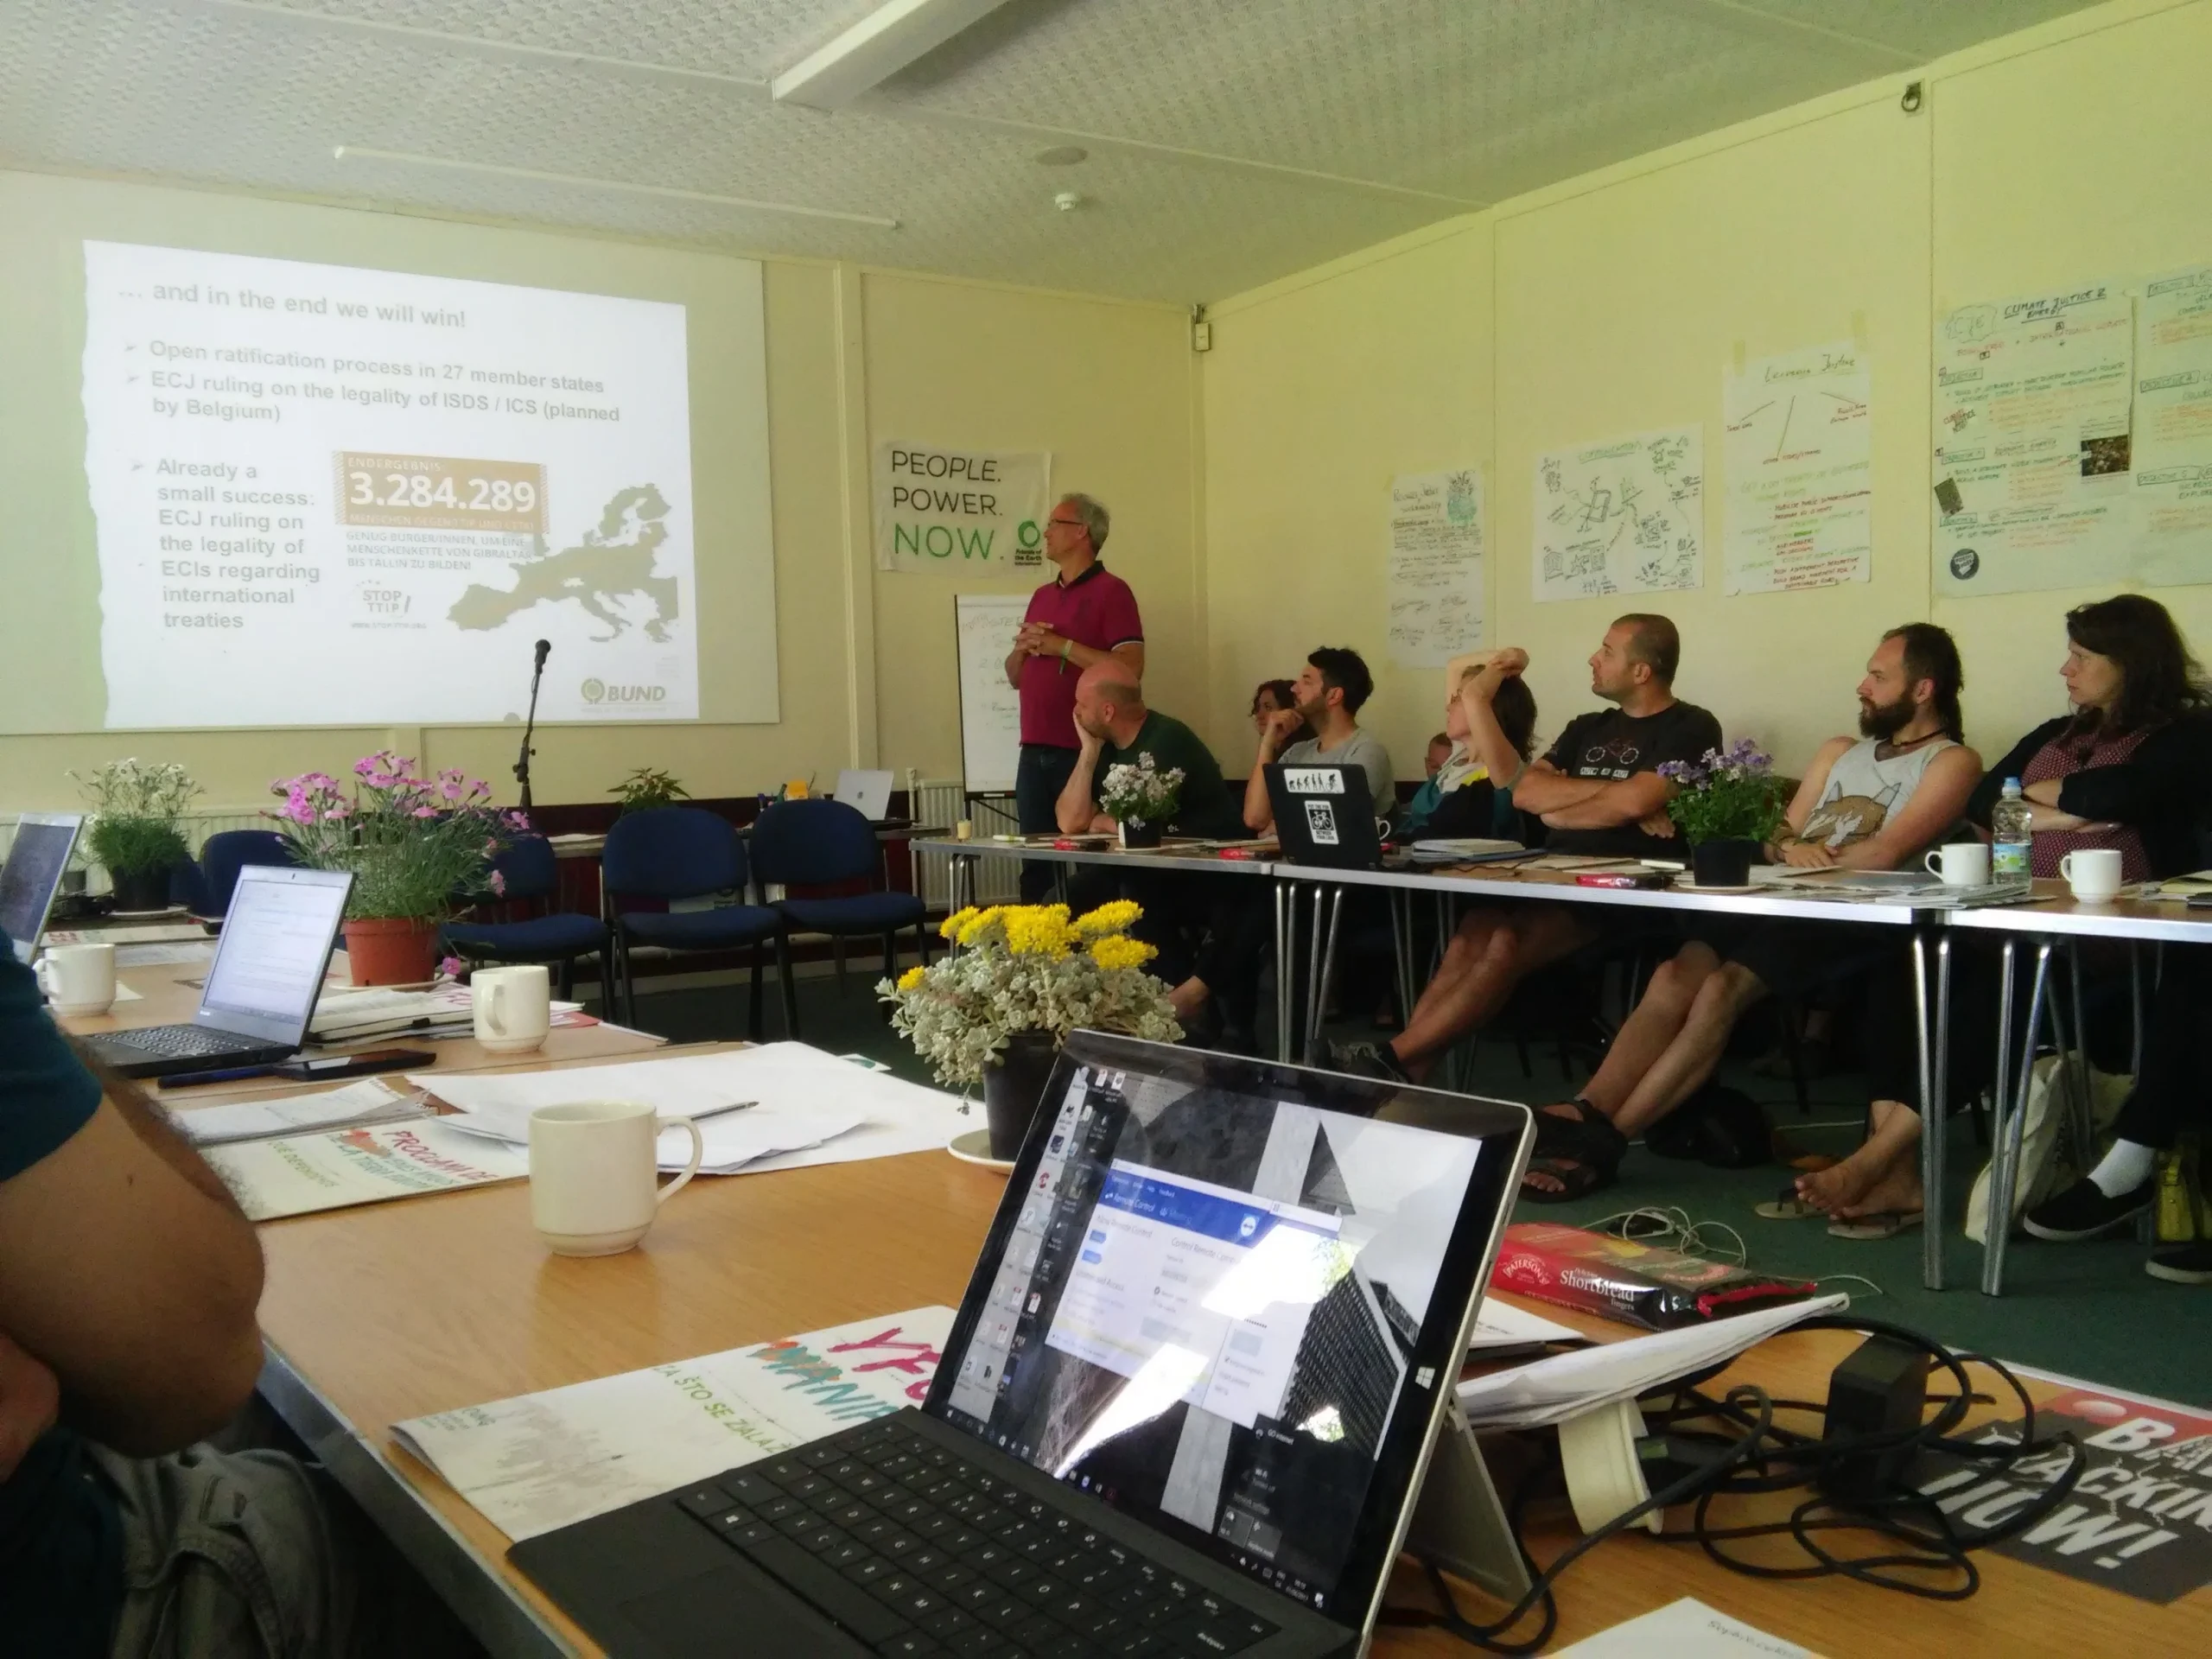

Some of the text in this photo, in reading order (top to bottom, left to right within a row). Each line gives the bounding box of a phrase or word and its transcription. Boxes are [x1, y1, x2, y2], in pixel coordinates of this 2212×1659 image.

[154, 283, 198, 304] and
[208, 287, 230, 307] in
[239, 289, 275, 309] the
[285, 293, 327, 315] end
[337, 302, 368, 319] we
[376, 302, 413, 324] will
[421, 306, 467, 329] win!
[149, 340, 605, 394] Open ratification process in 27 member states
[150, 372, 196, 391] ECJ
[204, 375, 264, 399] ruling
[271, 381, 297, 397] on
[303, 381, 335, 400] the
[340, 384, 412, 410] legality
[418, 389, 439, 407] of
[442, 391, 490, 410] ISDS
[505, 397, 538, 416] ICS
[543, 399, 621, 423] (planned
[152, 397, 282, 424] by Belgium)
[156, 459, 257, 482] Already a
[892, 449, 1002, 483] PEOPLE.
[158, 484, 315, 507] small success:
[349, 470, 537, 513] 3.284.289
[893, 486, 1004, 517] POWER.
[158, 509, 304, 534] ECJ ruling on
[160, 535, 305, 560] the legality of
[346, 543, 444, 557] MENSCHENKETTE
[446, 547, 471, 558] VON
[894, 521, 1005, 562] NOW.
[162, 561, 321, 586] ECIs regarding
[347, 557, 365, 568] BIS
[410, 560, 426, 569] ZU
[162, 586, 296, 607] international
[362, 589, 404, 602] STOP
[163, 611, 245, 630] treaties
[607, 685, 666, 702] BUND
[1133, 1198, 1156, 1212] Control
[1169, 1236, 1193, 1251] Control
[1192, 1243, 1217, 1258] Remote
[1558, 1268, 1635, 1303] Shortbread
[702, 1399, 734, 1419] SE
